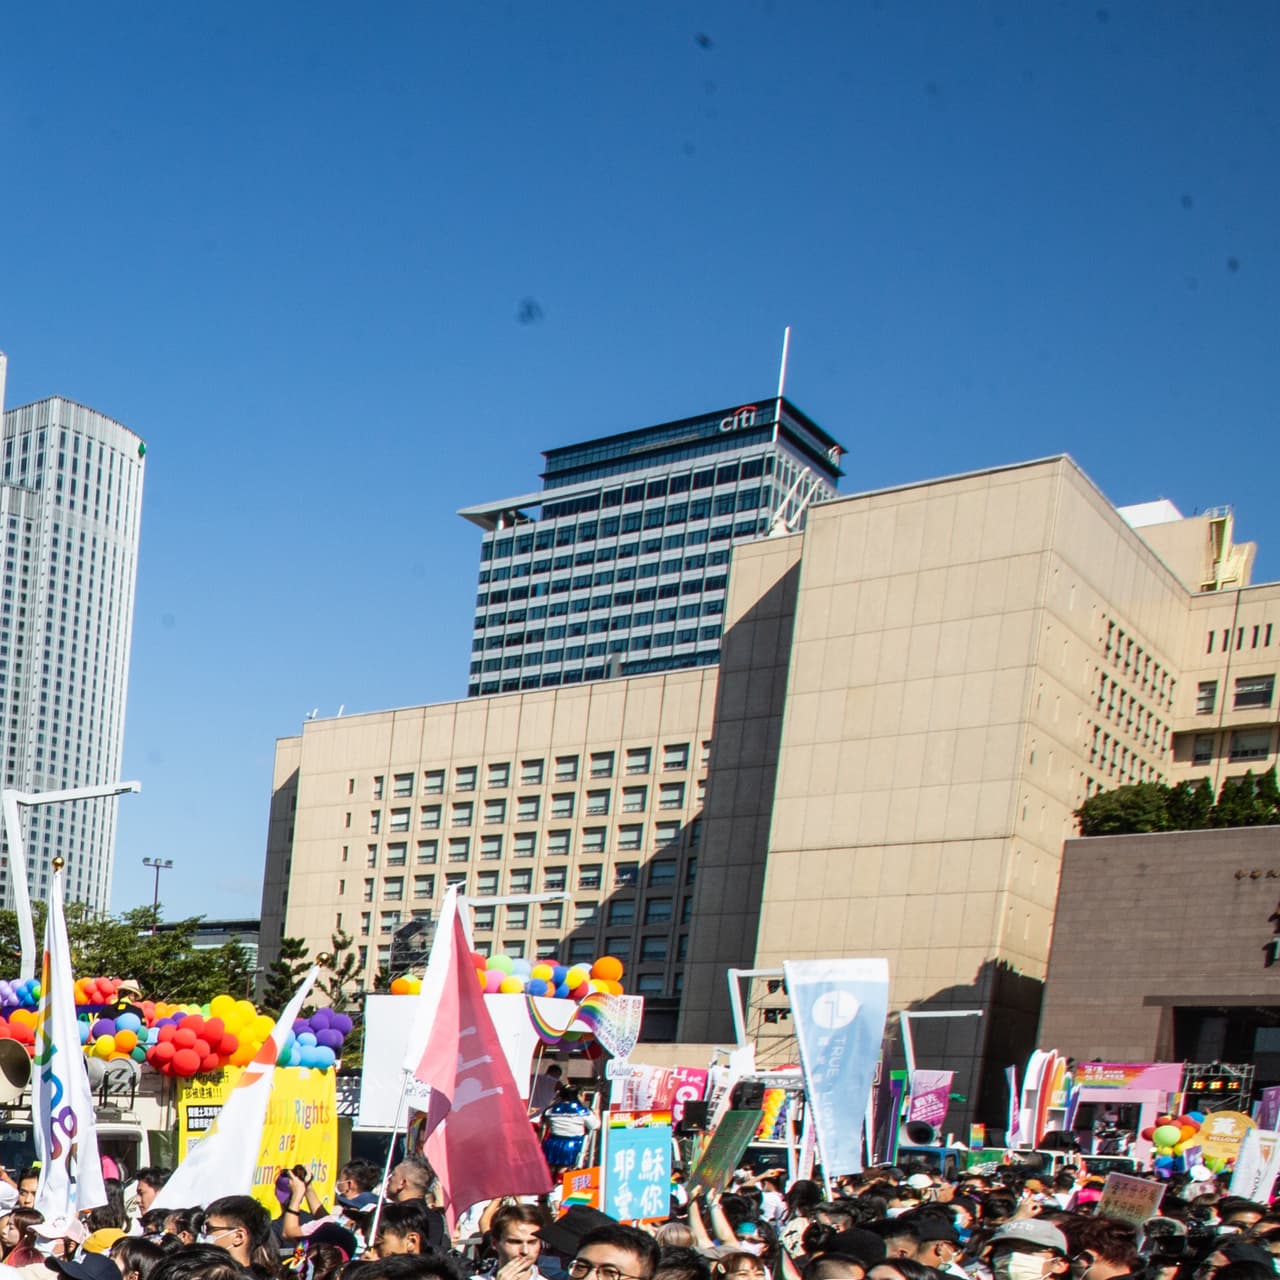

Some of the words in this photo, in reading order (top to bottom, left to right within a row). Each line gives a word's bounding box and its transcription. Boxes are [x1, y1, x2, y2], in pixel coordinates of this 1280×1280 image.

[720, 406, 757, 432] citi
[294, 1100, 330, 1129] Rights
[279, 1134, 295, 1151] are
